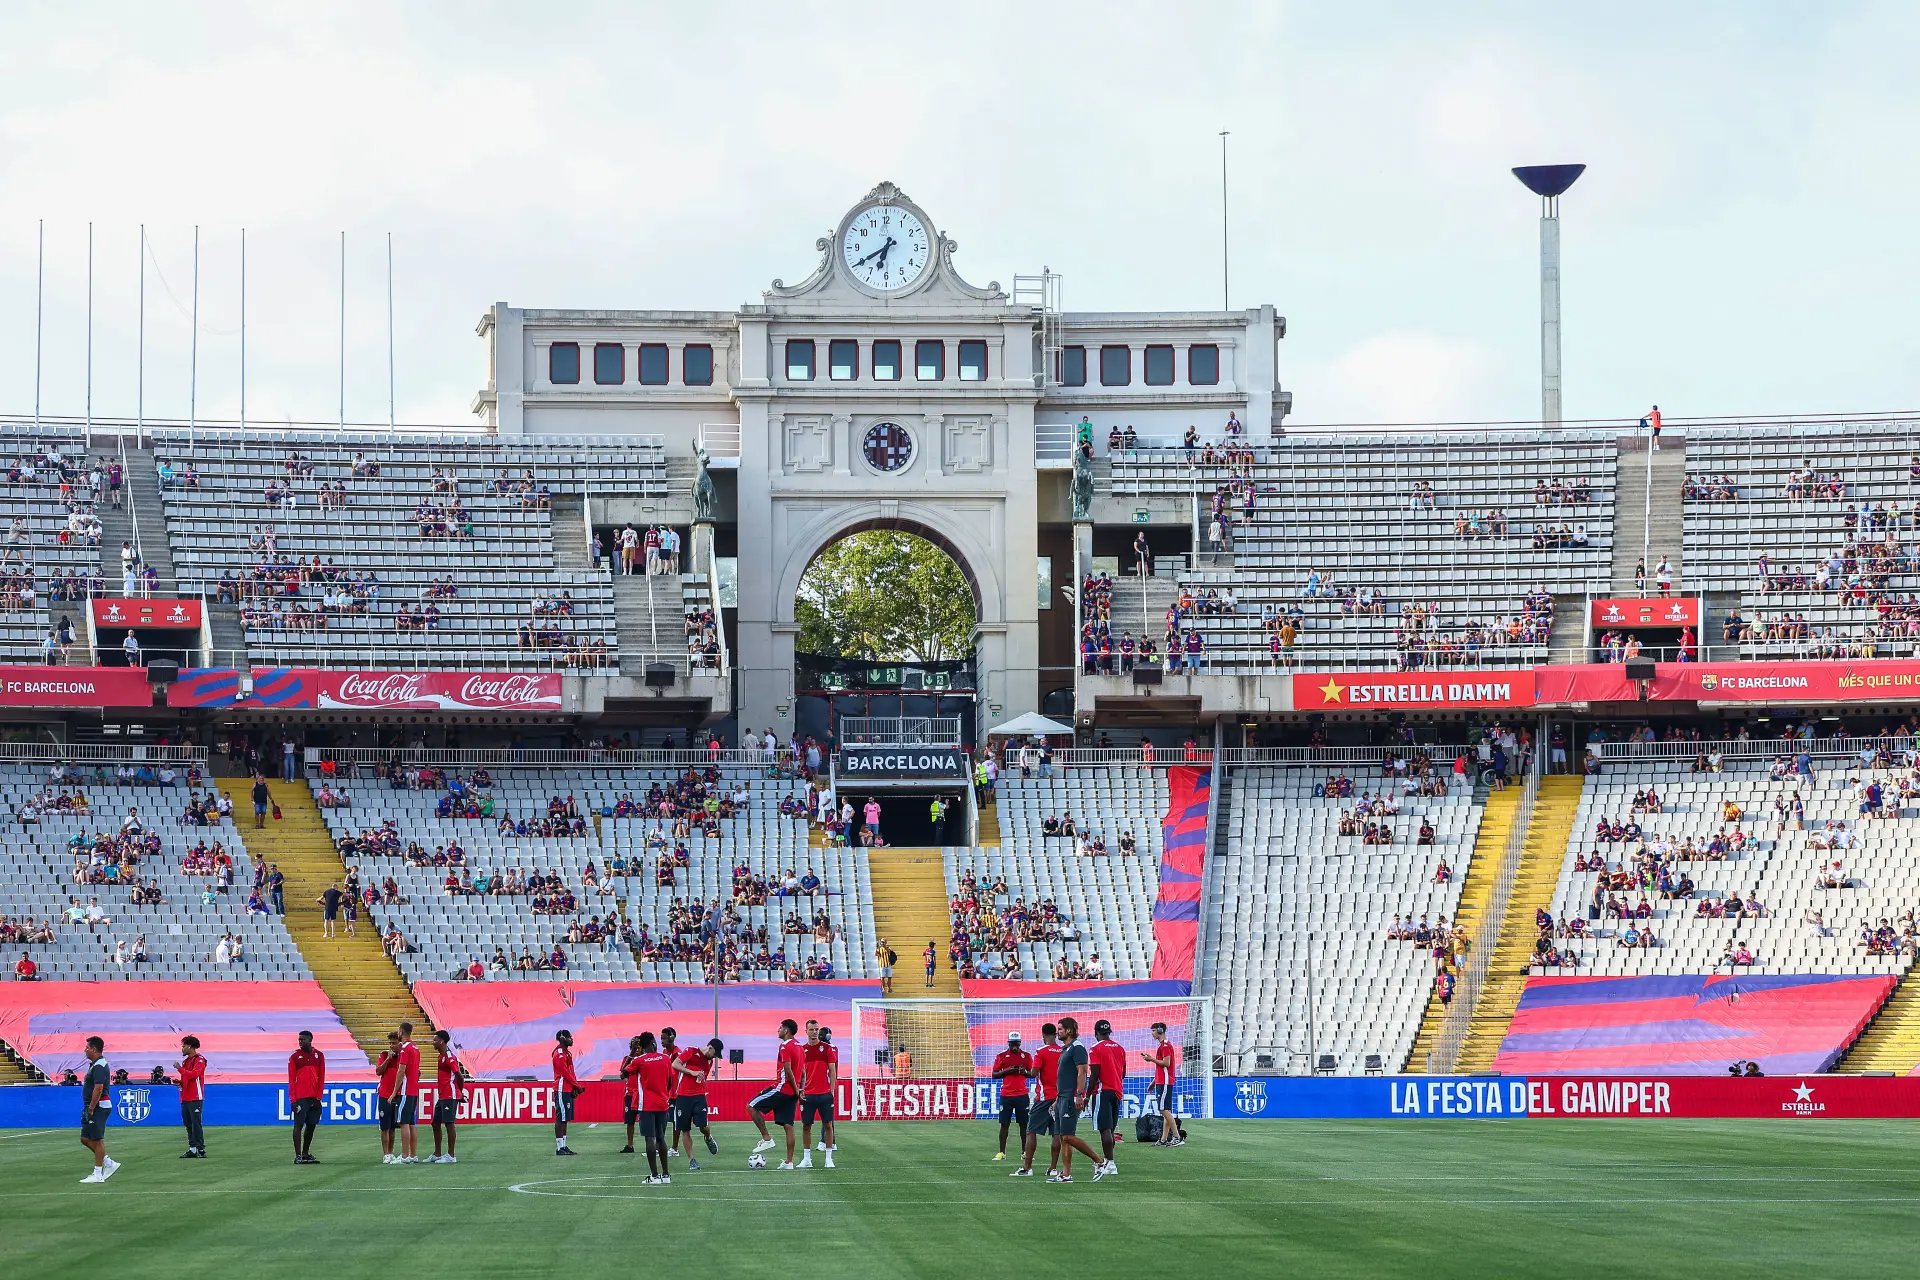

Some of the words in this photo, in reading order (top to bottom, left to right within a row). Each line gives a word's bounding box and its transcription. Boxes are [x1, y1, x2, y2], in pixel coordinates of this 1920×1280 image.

[870, 220, 877, 228] 11
[882, 216, 890, 224] 12
[899, 220, 903, 228] 1
[860, 229, 868, 237] 10
[909, 229, 914, 237] 2
[855, 243, 860, 251] 9
[908, 258, 913, 266] 4
[868, 267, 873, 275] 7
[899, 267, 904, 275] 5
[884, 272, 889, 280] 6
[1721, 677, 1736, 688] FC
[1738, 676, 1808, 689] BARCELONA
[1838, 673, 1864, 688] MÉS
[1866, 675, 1892, 688] QUE
[1894, 674, 1912, 686] UN
[7, 681, 22, 693] FC
[24, 682, 95, 694] BARCELONA
[339, 673, 424, 701] Coca-Cola
[461, 675, 543, 702] Coca-Cola
[1348, 684, 1445, 702] ESTRELLA
[1448, 683, 1510, 702] DAMM
[847, 755, 957, 770] BARCELONA
[838, 1084, 868, 1116] LA
[874, 1084, 950, 1116] FESTA
[957, 1084, 1001, 1115] DEL
[1391, 1082, 1420, 1114] LA
[1427, 1082, 1502, 1114] FESTA
[1510, 1082, 1555, 1113] DEL
[1561, 1082, 1671, 1113] GAMPER
[1782, 1102, 1826, 1111] ESTRELLA
